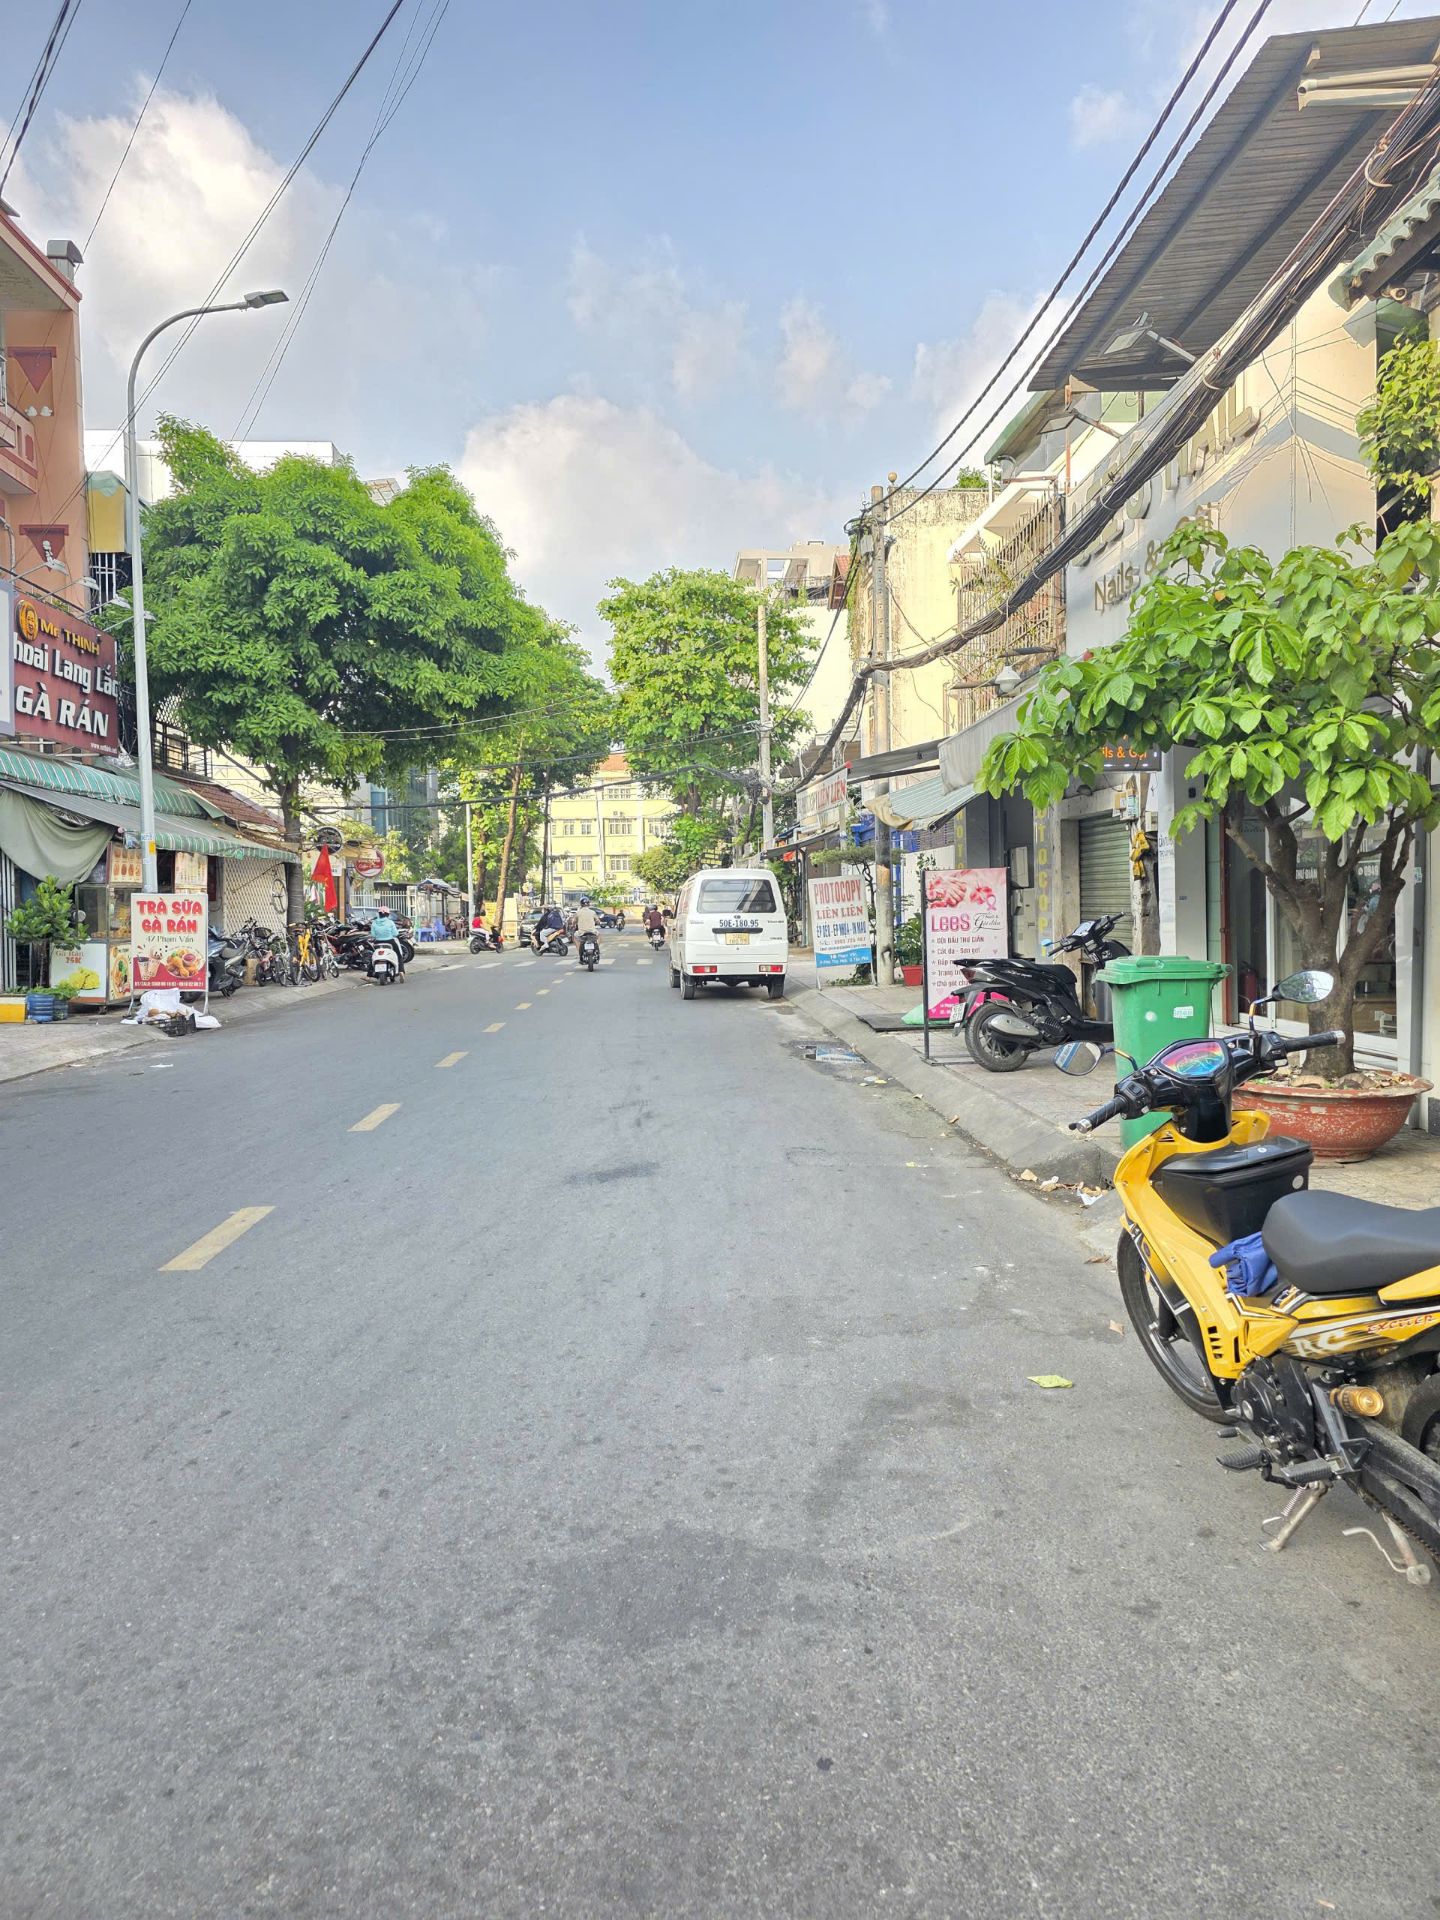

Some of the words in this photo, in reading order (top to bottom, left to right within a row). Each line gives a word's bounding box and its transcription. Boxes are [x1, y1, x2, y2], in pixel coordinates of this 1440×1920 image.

[1095, 561, 1134, 613] Nails
[55, 649, 91, 694] Lang
[16, 683, 52, 721] GÀ
[59, 699, 109, 737] RÁN
[814, 880, 862, 905] PHOTOCOPY
[136, 897, 168, 915] TRÀ
[171, 898, 203, 916] SỮA
[816, 906, 839, 919] LIÊN
[841, 904, 863, 917] LIÊN
[141, 915, 162, 933] GÀ
[167, 915, 197, 933] RÁN
[719, 919, 760, 928] 50E-180.95
